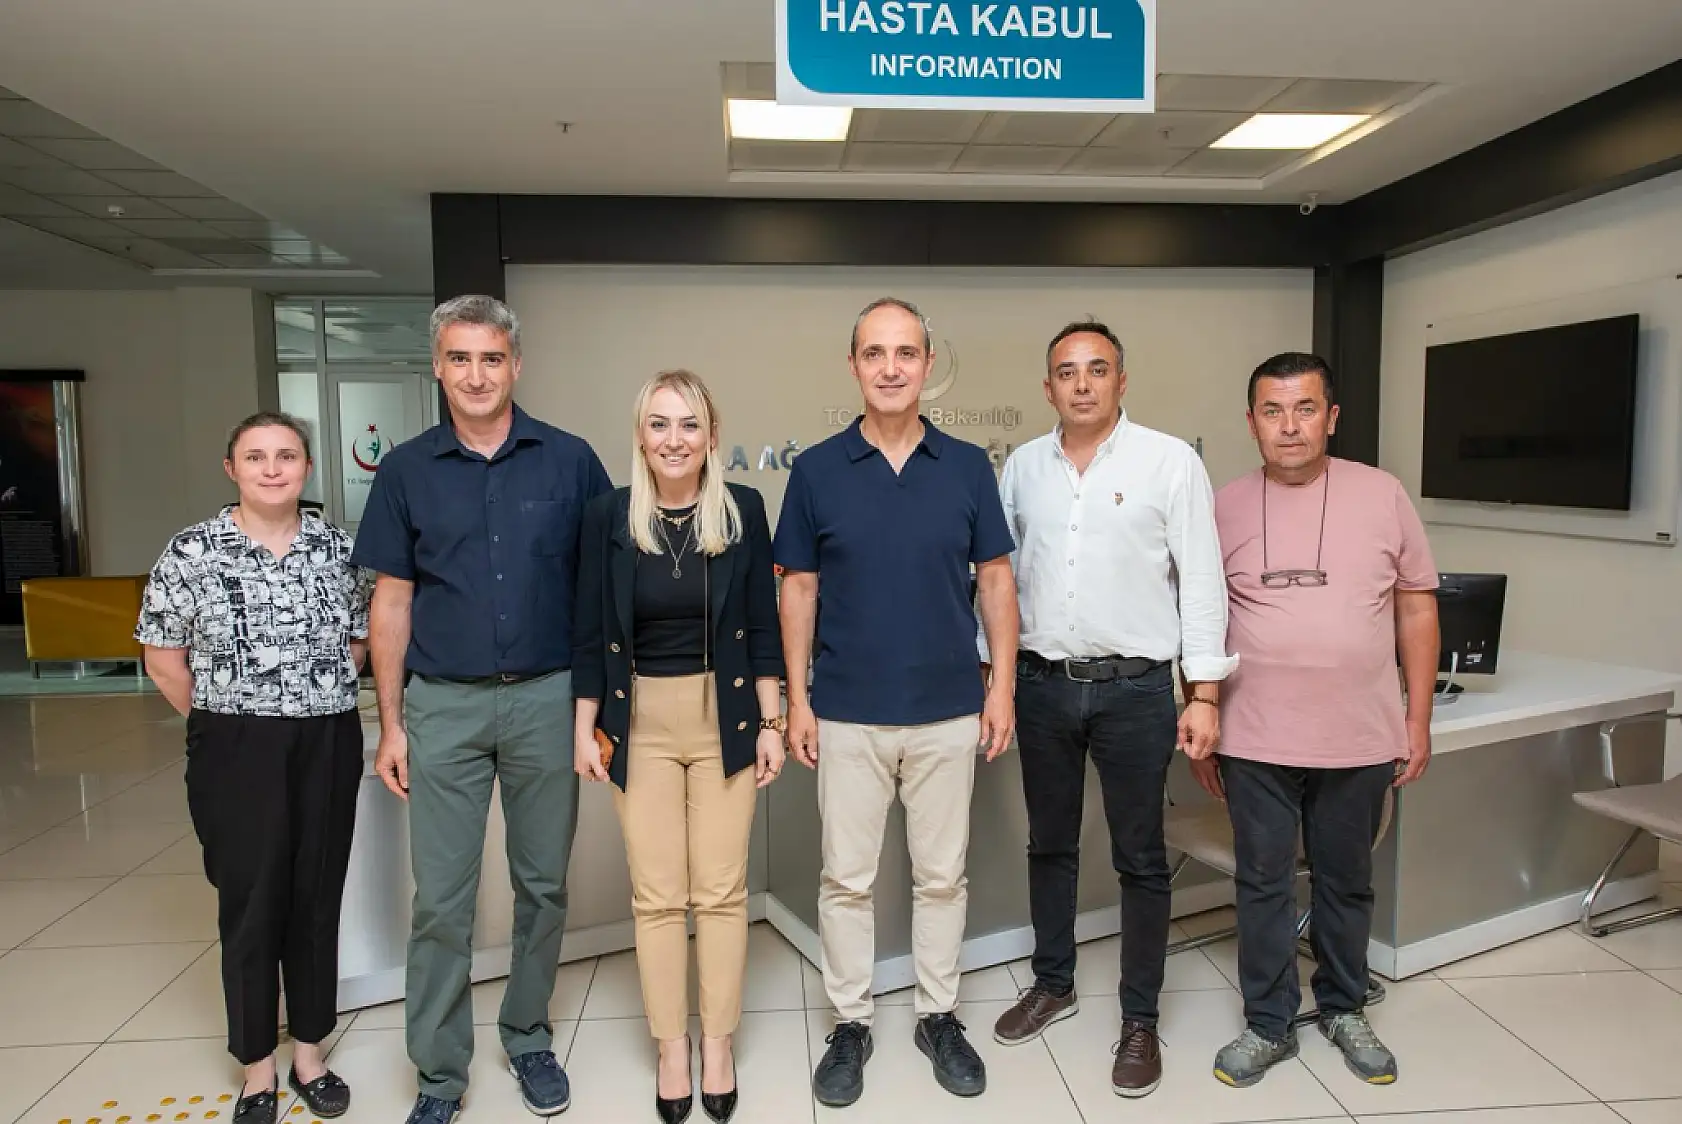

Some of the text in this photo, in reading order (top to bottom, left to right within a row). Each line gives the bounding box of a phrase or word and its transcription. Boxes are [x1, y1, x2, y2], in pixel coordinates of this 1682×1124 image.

[819, 0, 1113, 39] HASTA KABUL
[870, 53, 1062, 80] INFORMATION
[929, 406, 1022, 431] Bakanlığı
